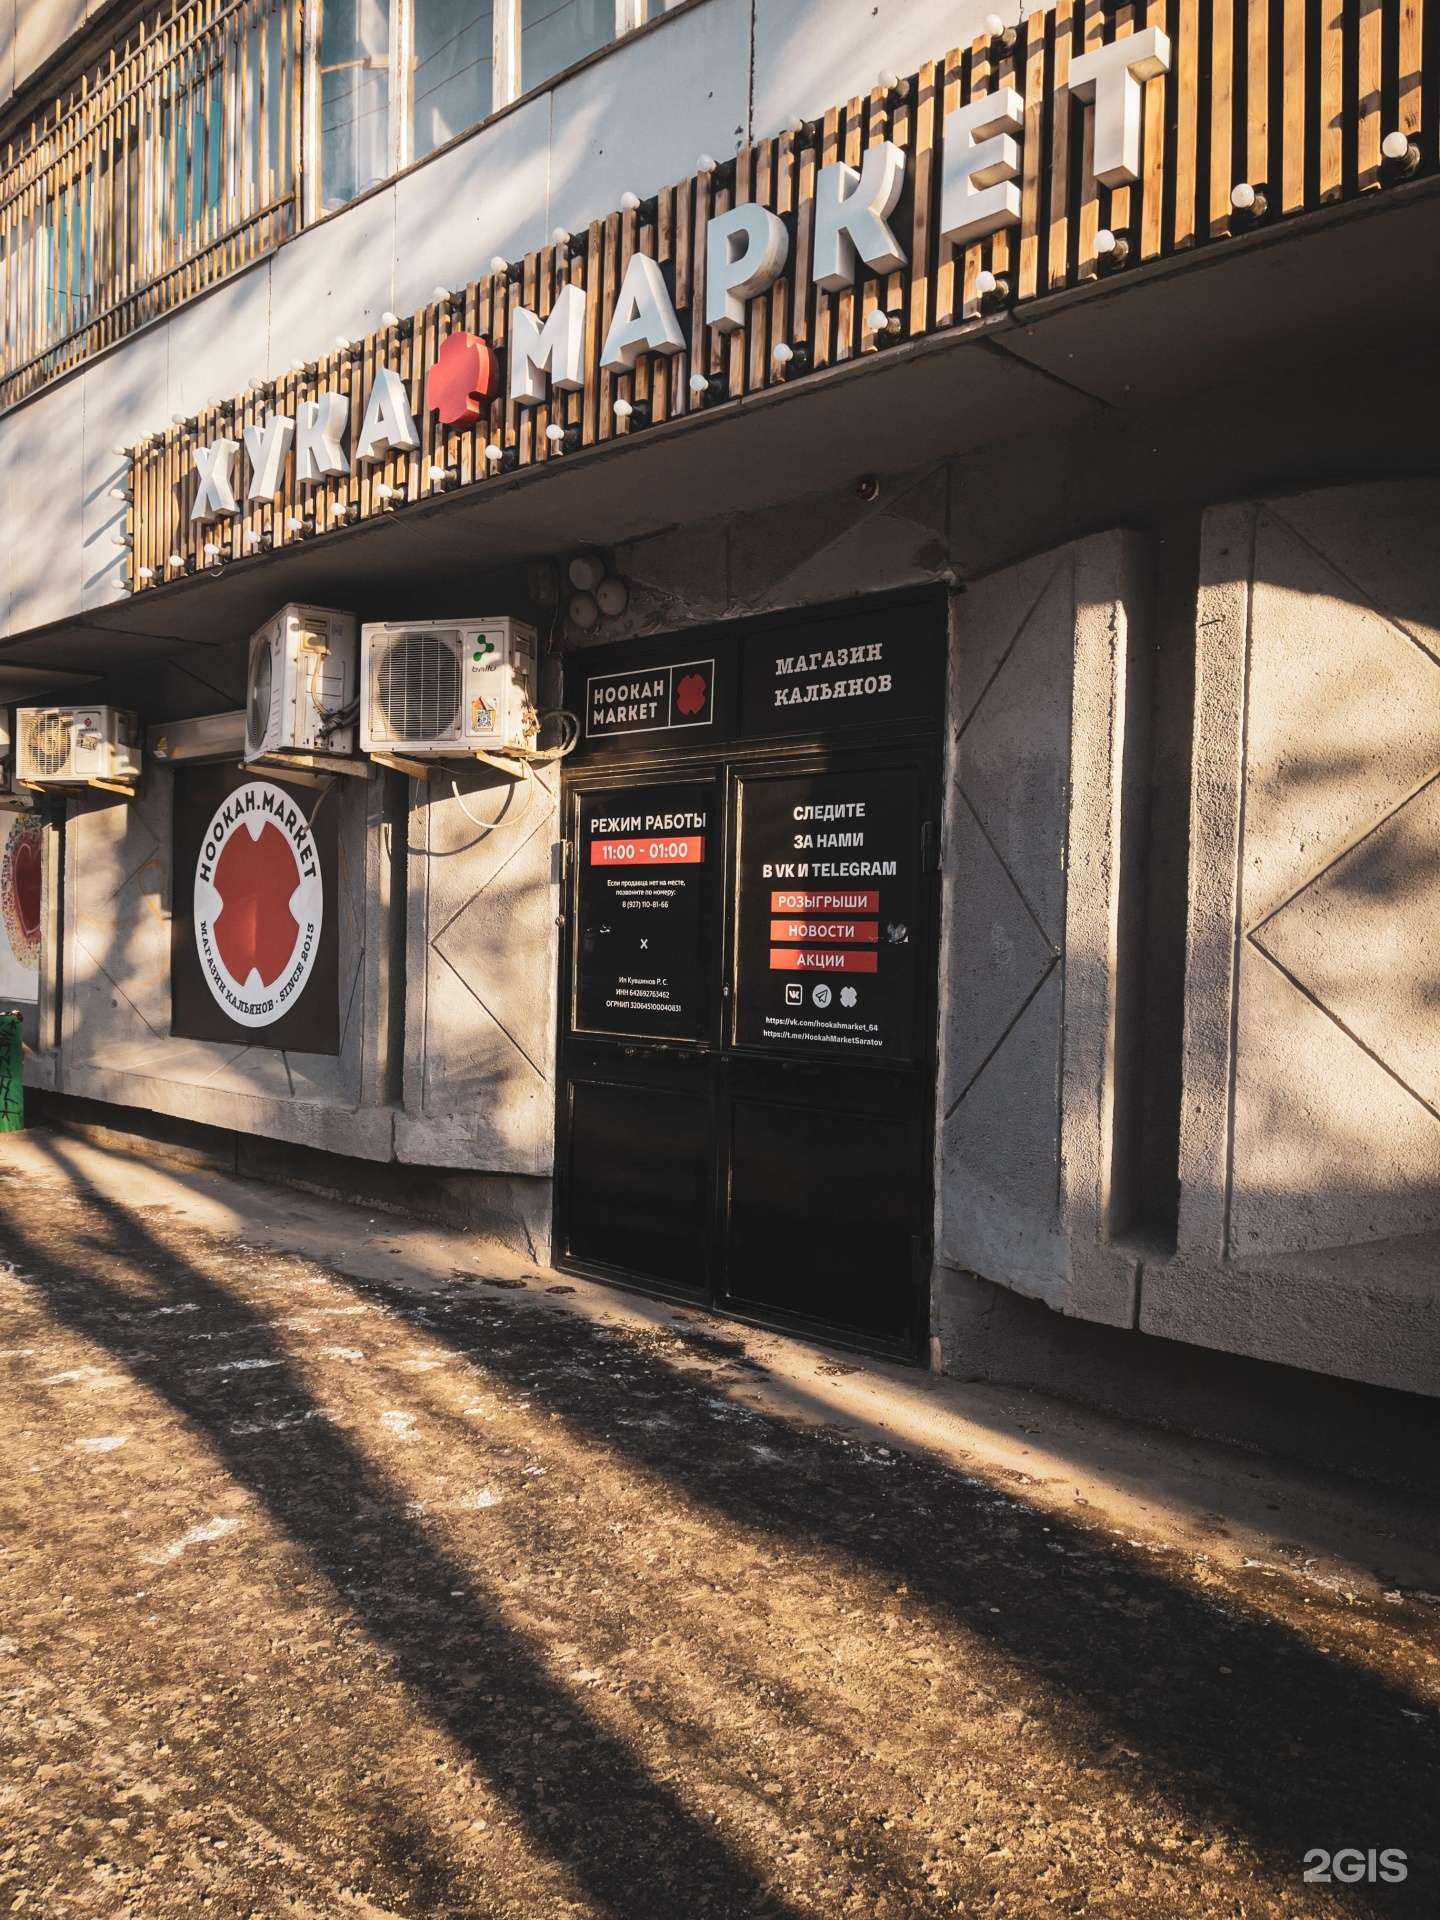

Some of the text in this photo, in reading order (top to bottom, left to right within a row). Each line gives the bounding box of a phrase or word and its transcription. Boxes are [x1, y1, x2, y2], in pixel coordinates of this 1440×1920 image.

[191, 26, 1171, 523] ХУКА МАРКЕТ
[775, 643, 882, 675] МАГАЗИН
[594, 679, 664, 704] HOOKAH
[774, 674, 893, 706] КАЛЬЯНОВ
[593, 702, 658, 725] MARKET
[793, 802, 866, 821] СЛЕДИТЕ
[590, 812, 706, 833] РЕЖИМ РАБОТЫ
[793, 832, 864, 849] ЗА НАМИ
[602, 844, 635, 860] 11:00
[649, 842, 688, 858] 01:00
[775, 864, 795, 878] VK
[797, 863, 809, 877] И
[811, 860, 897, 877] TELEGRAM
[627, 901, 641, 909] (927)
[778, 895, 868, 908] РОЗЫГРЫШИ
[788, 924, 855, 937] НОВОСТИ
[200, 921, 315, 1015] МАГАЗИН КАЛЬЯНОВ SINCE 2013
[796, 953, 846, 969] АКЦИИ
[605, 1000, 630, 1009] ОГРНИП
[765, 1016, 879, 1032] https://vk.com/hookahmarket_64
[763, 1029, 883, 1046] https://t.me/HookahMarketSaratov
